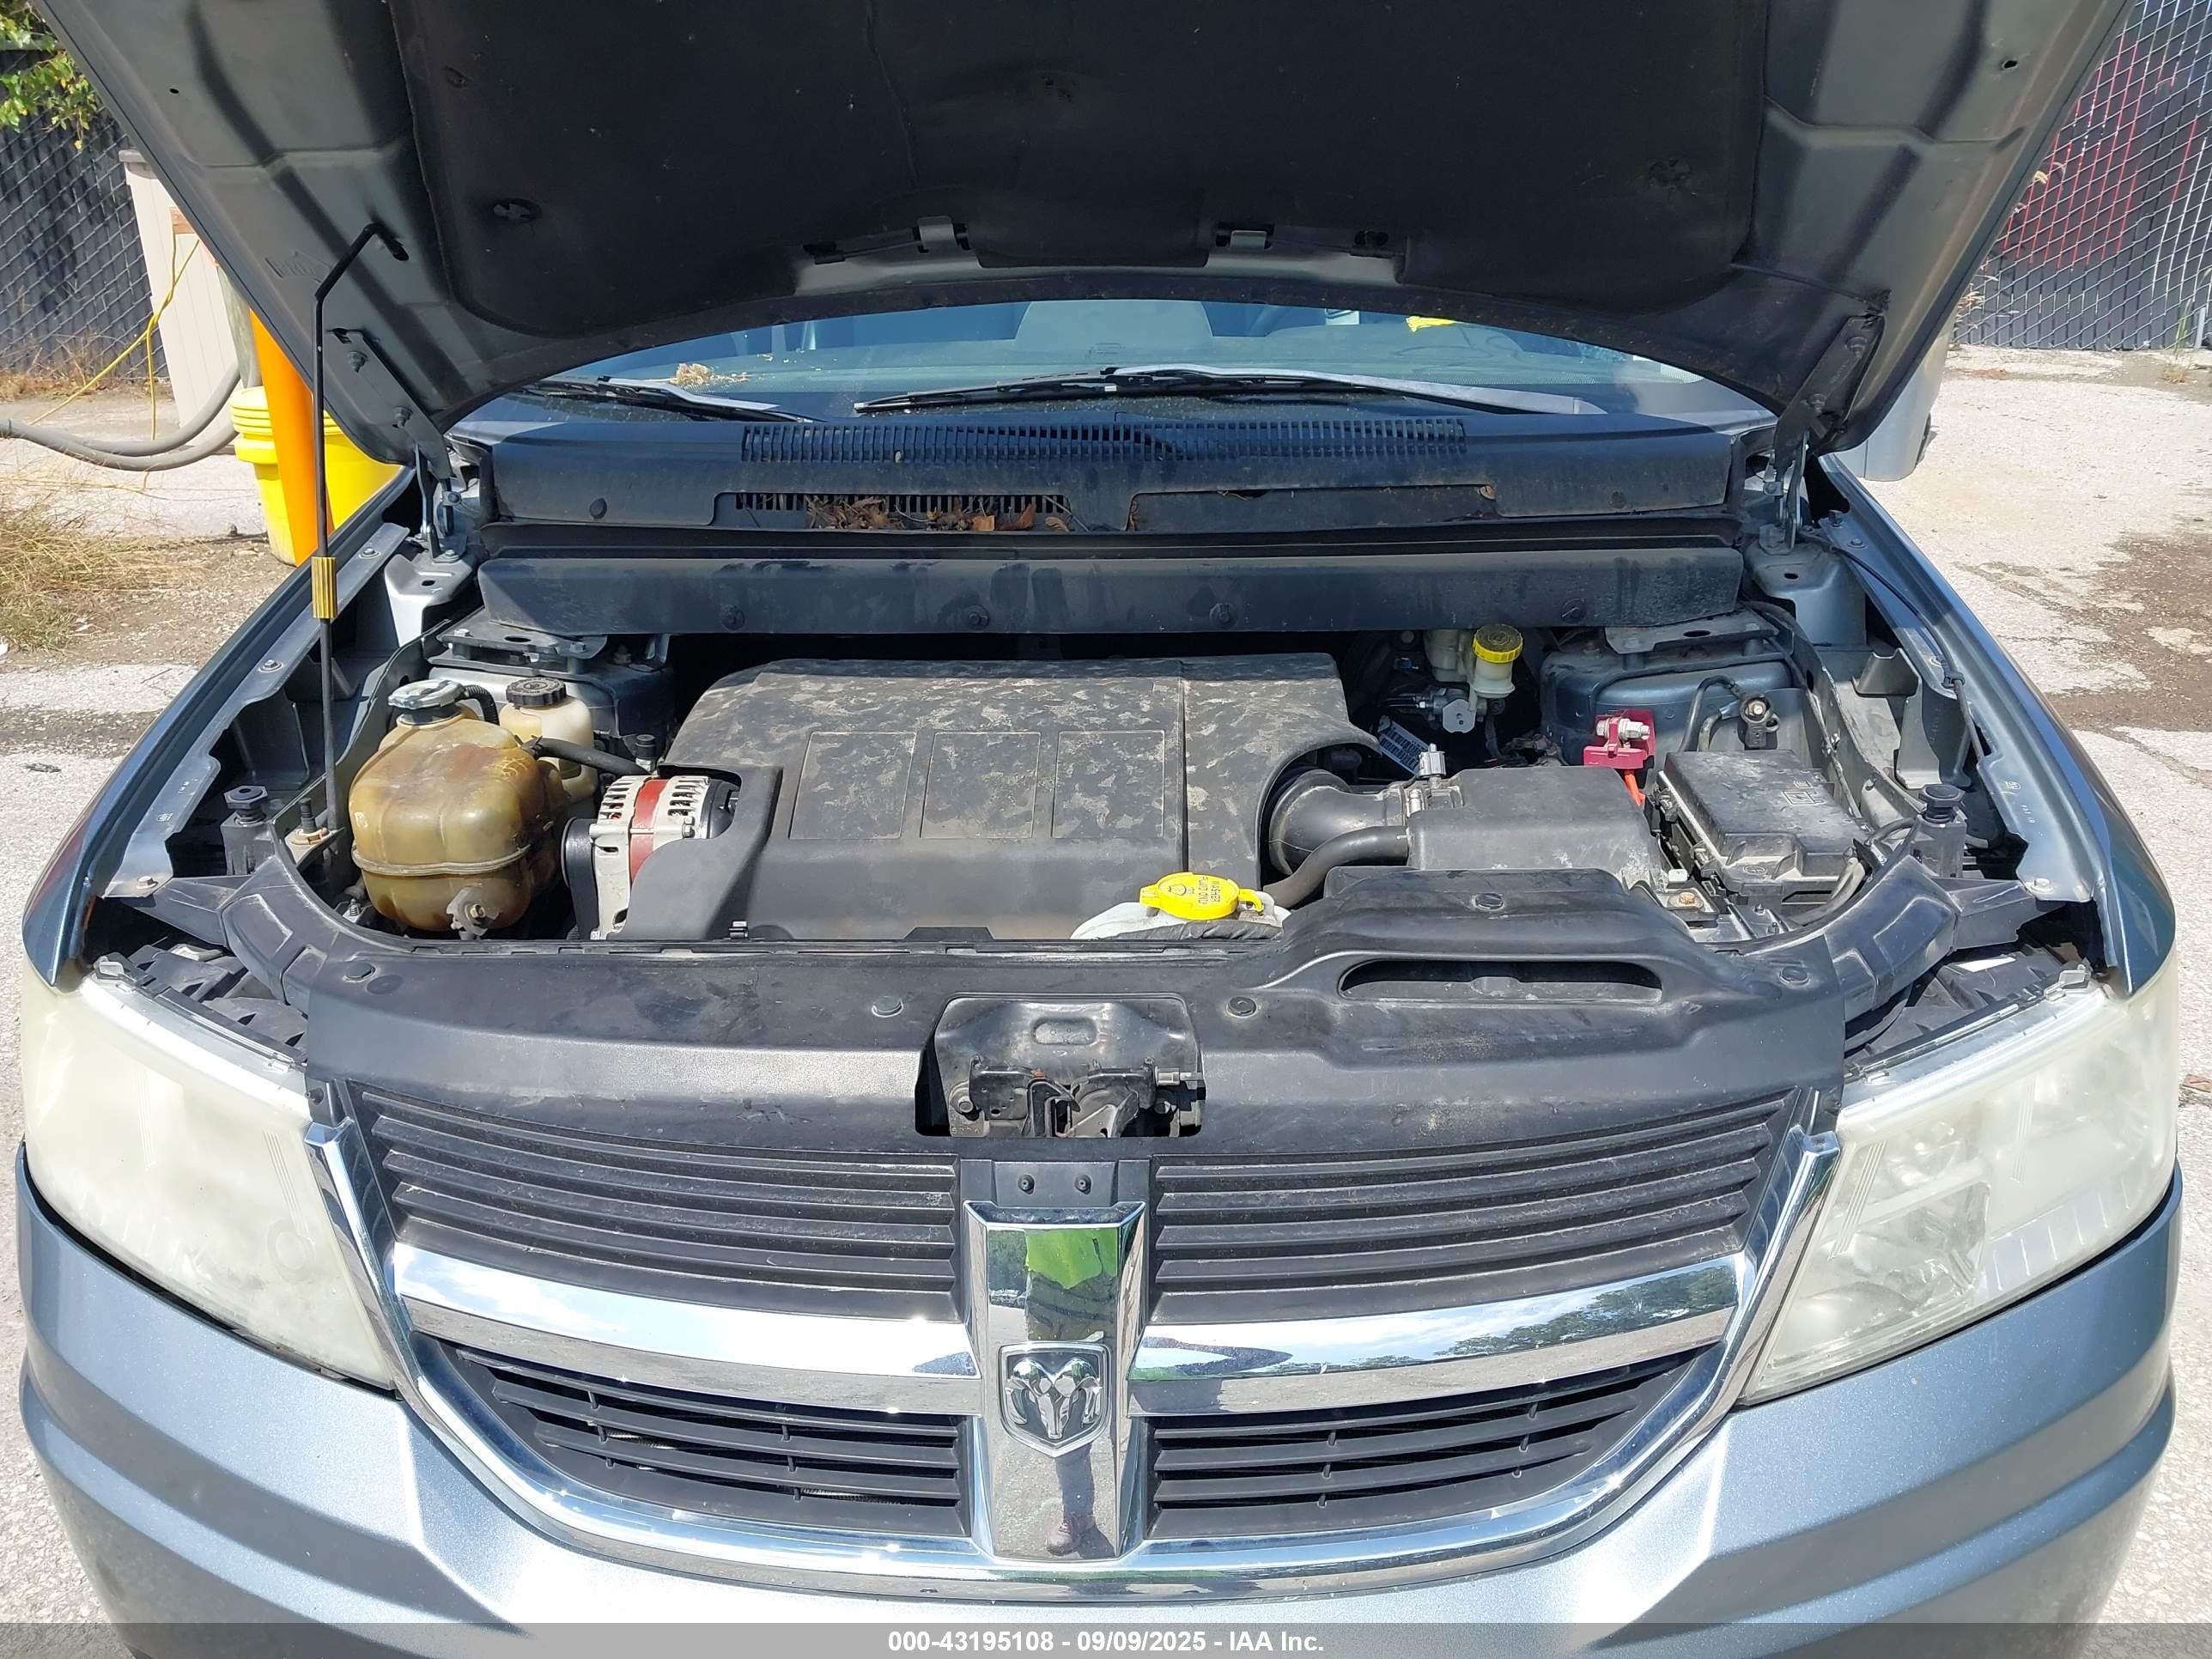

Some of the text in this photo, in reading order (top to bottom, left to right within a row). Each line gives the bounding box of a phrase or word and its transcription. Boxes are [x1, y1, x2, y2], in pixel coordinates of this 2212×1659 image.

[1198, 876, 1209, 905] FLUID ONLY
[1210, 880, 1221, 902] WASHER
